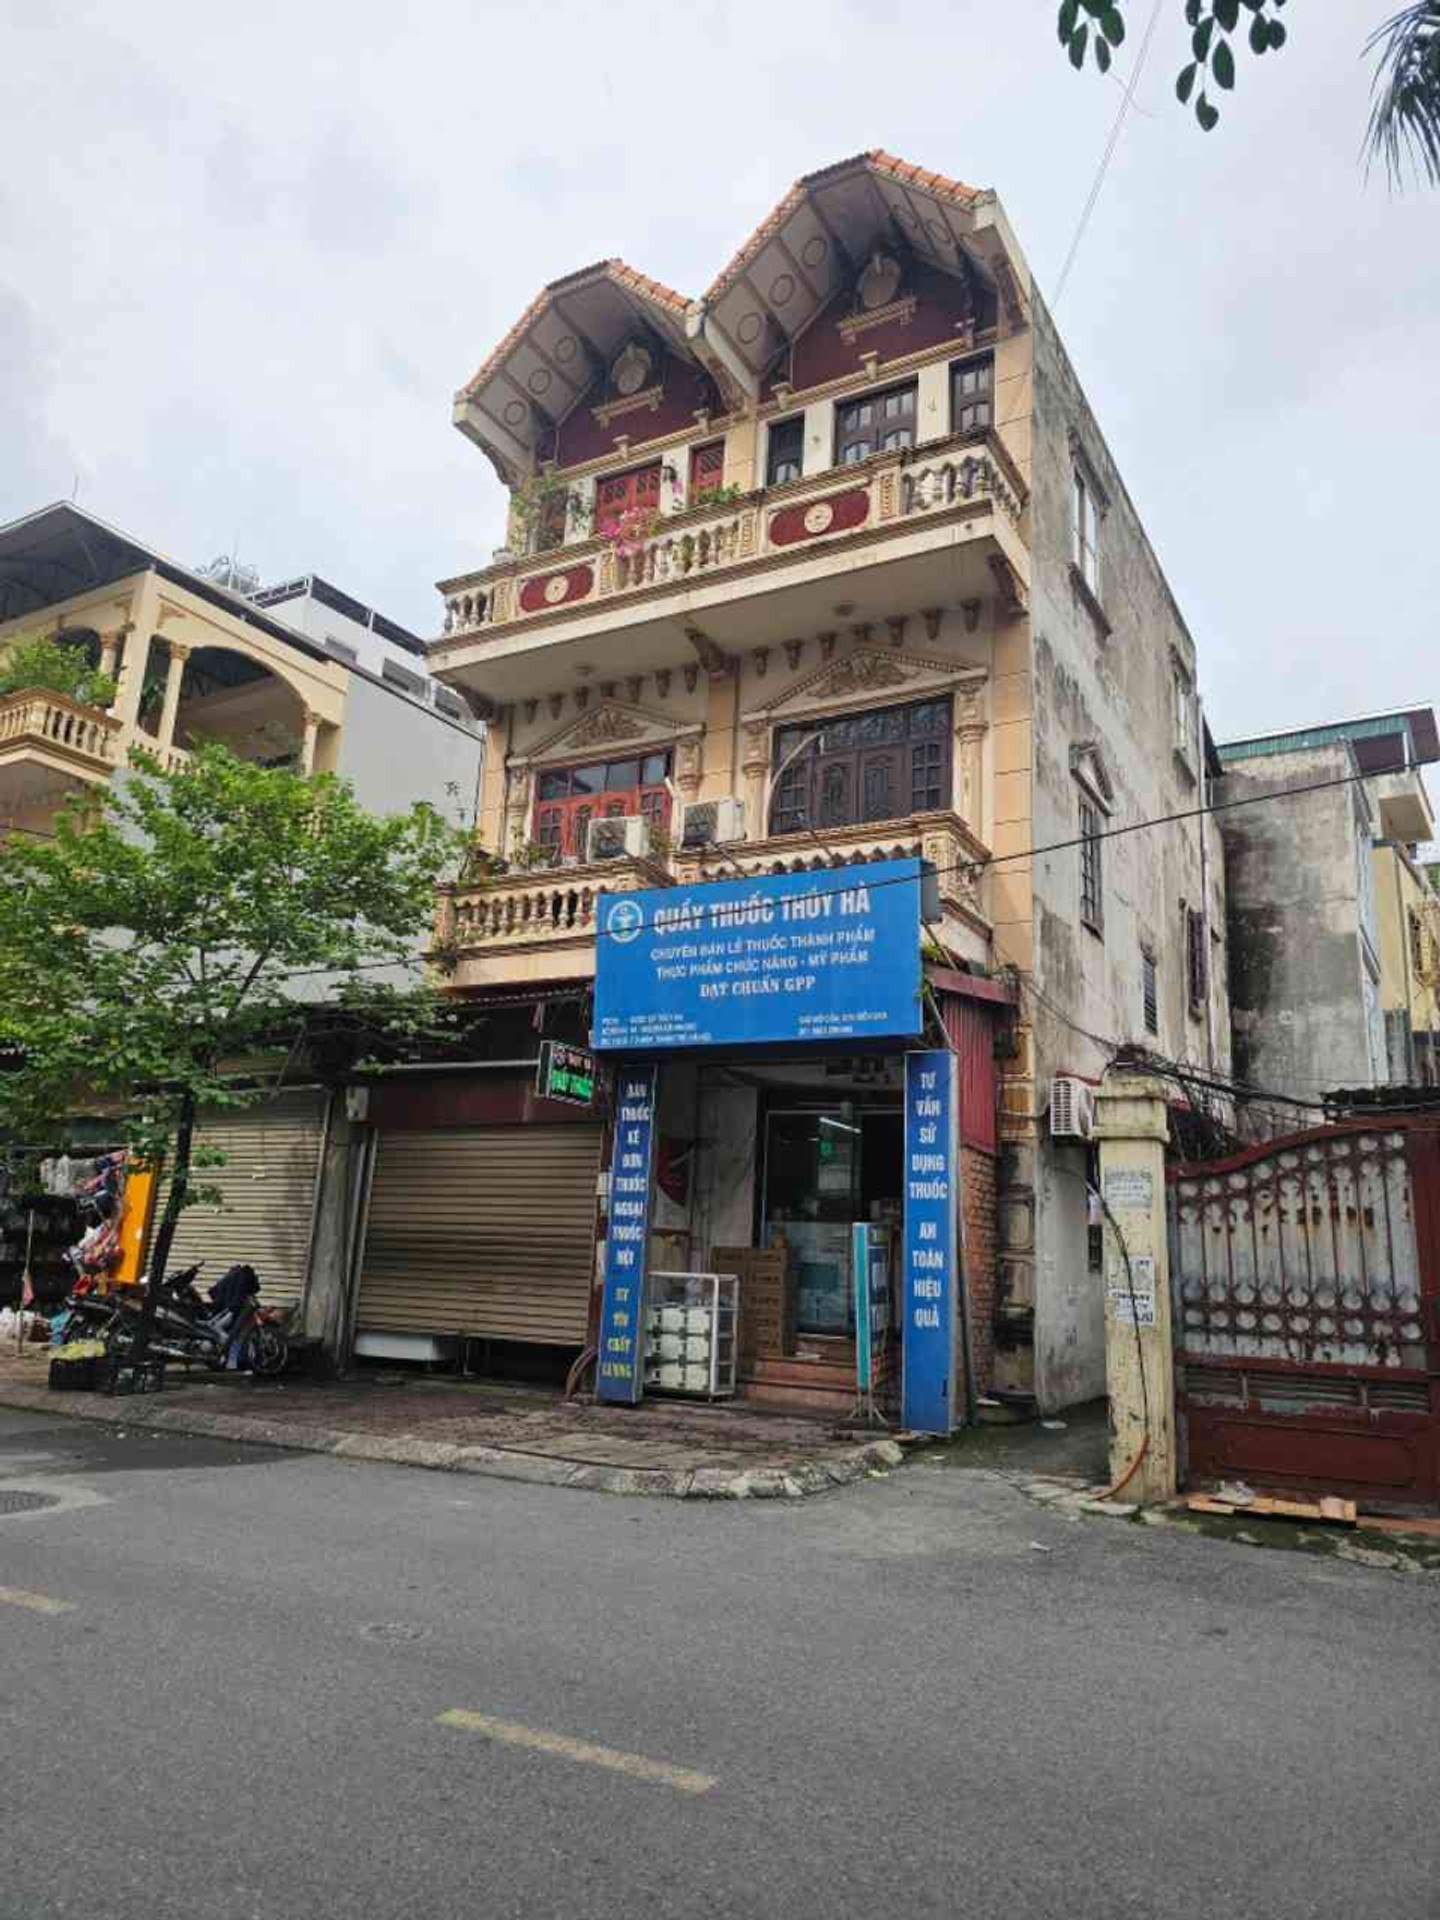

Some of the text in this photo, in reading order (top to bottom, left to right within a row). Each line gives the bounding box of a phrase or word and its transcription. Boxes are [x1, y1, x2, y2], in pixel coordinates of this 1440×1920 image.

[709, 889, 774, 929] THUỐC
[840, 879, 871, 915] HÀ
[744, 933, 788, 952] THUỐC
[784, 975, 817, 993] GPP
[909, 1178, 948, 1200] THUỐC
